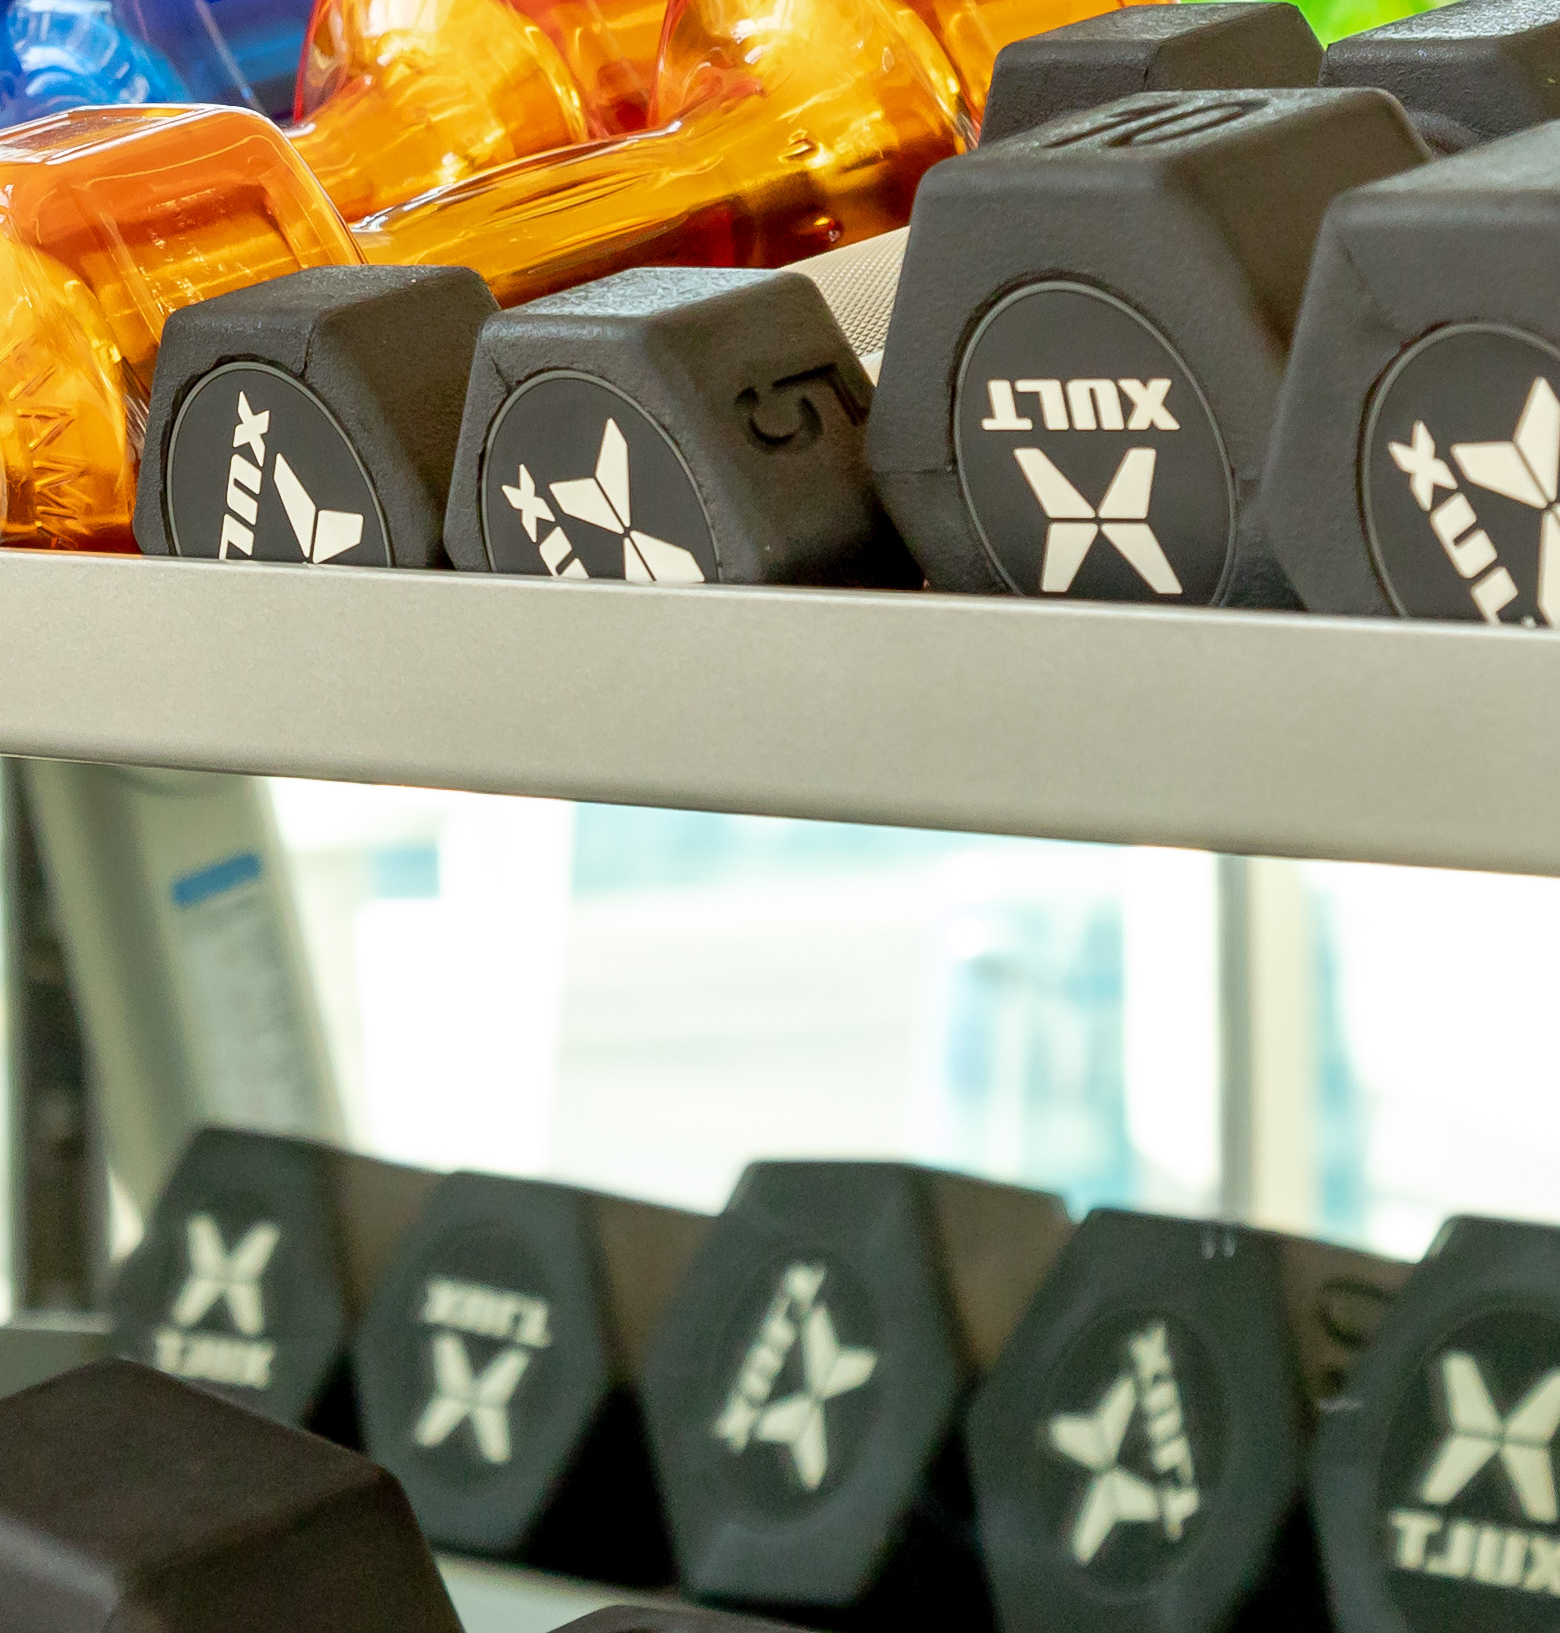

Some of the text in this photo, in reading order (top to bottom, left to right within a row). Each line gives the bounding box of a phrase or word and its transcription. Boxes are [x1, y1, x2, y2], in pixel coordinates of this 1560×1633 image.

[732, 363, 871, 452] 5
[981, 378, 1181, 431] XULT
[218, 390, 270, 560] XUL
[501, 463, 590, 579] XU
[1387, 419, 1520, 626] XUL
